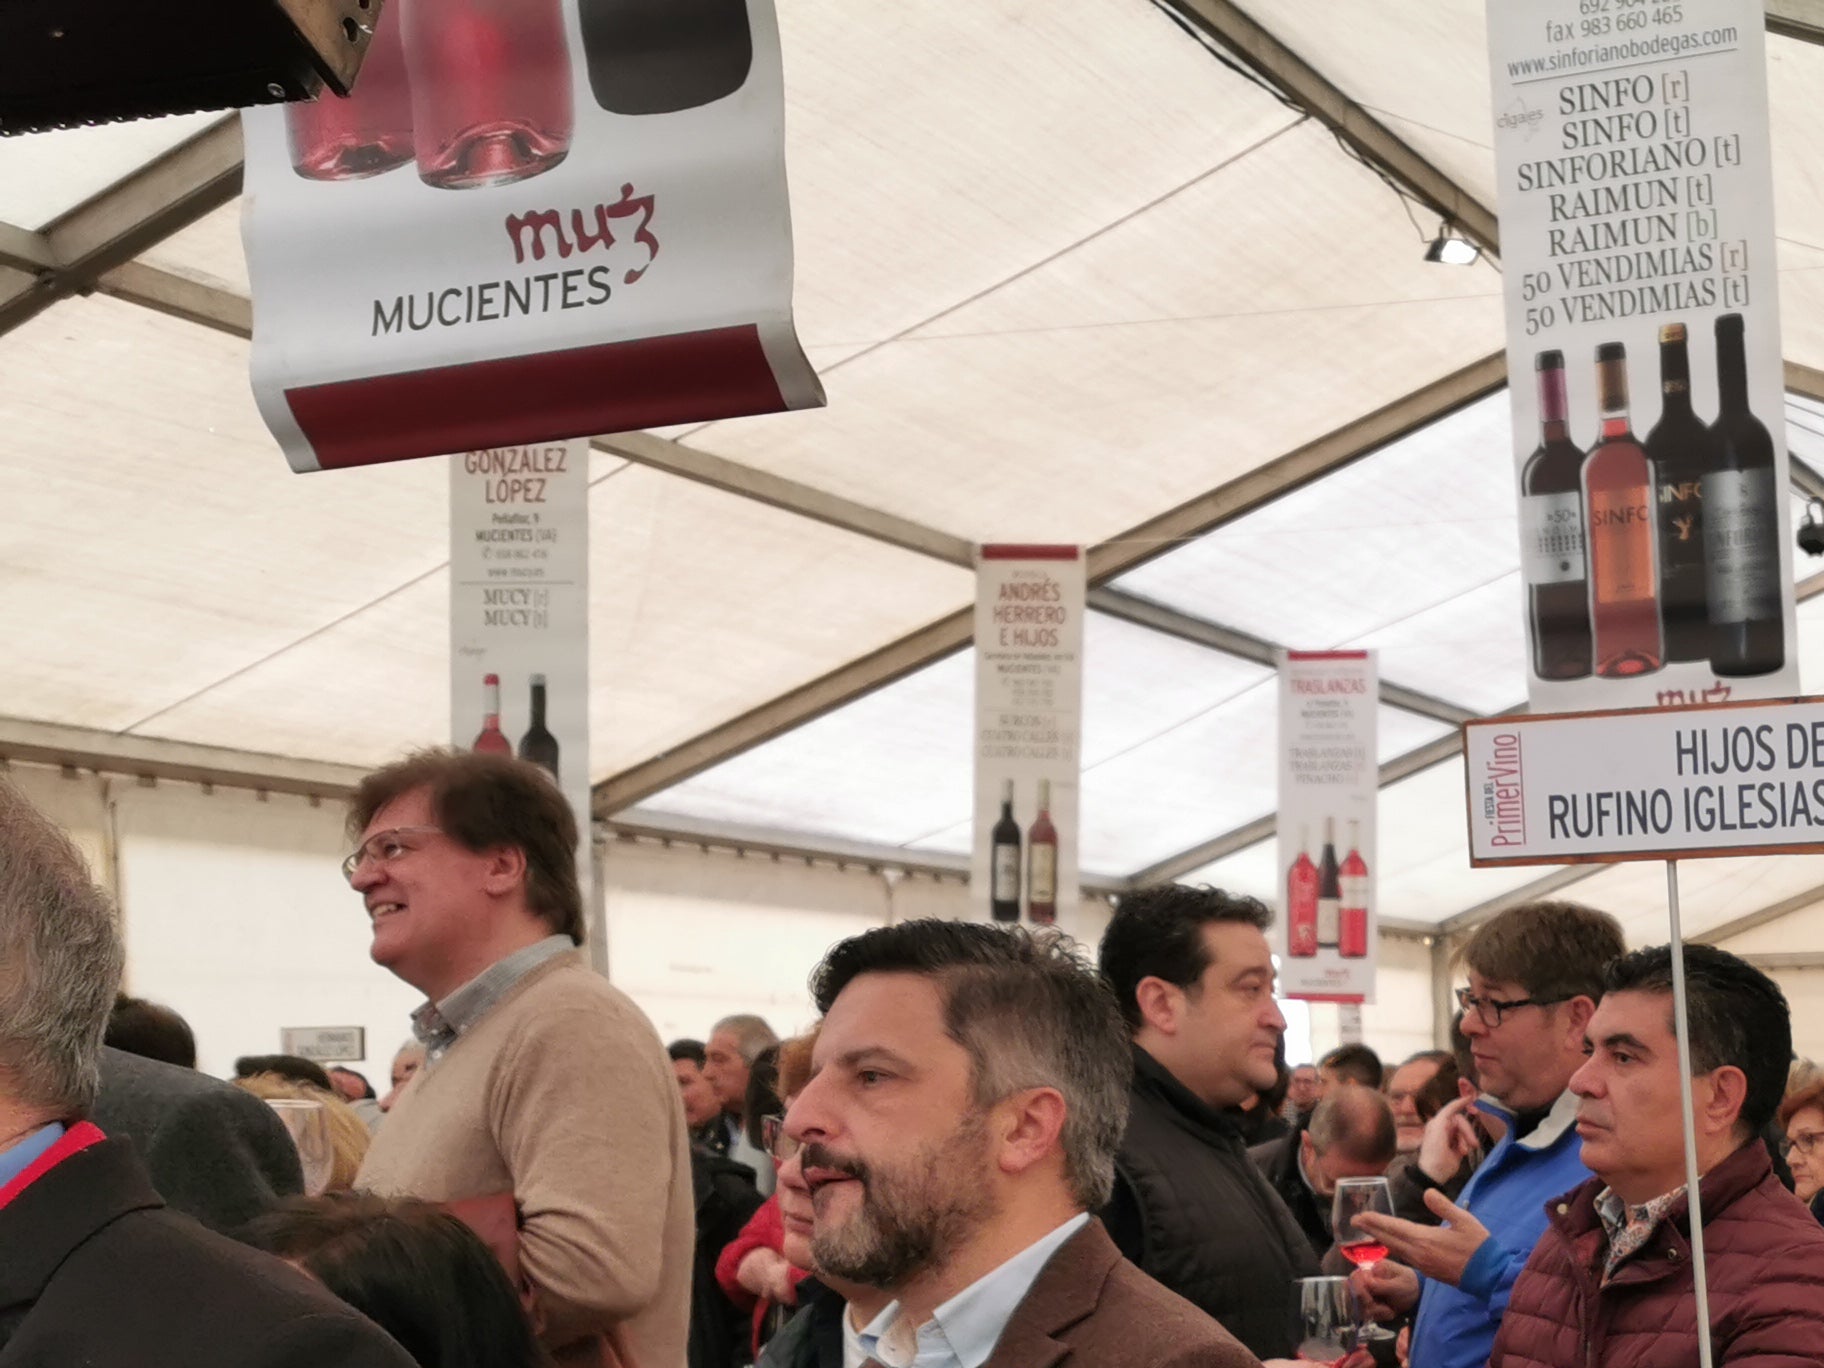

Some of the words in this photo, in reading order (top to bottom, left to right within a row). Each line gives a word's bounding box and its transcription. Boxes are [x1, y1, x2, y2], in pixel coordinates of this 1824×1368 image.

[1546, 20, 1574, 43] fax
[1581, 16, 1611, 38] 983
[1616, 10, 1648, 32] 660
[1652, 5, 1684, 25] 465
[1507, 26, 1738, 77] www.sinforianobodegas.com
[1559, 75, 1654, 116] SINFO
[1661, 70, 1690, 105] [r]
[1562, 110, 1657, 150] SINFO
[1664, 106, 1691, 140] [t]
[1517, 138, 1706, 191] SINFORIANO
[1713, 134, 1741, 168] [t]
[1549, 177, 1679, 222] RAIMUN
[1686, 173, 1713, 207] [t]
[1548, 212, 1678, 257] RAIMUN
[1686, 209, 1718, 242] [b]
[1523, 271, 1551, 301] 50
[1557, 243, 1714, 291] VENDIMIAS
[1720, 240, 1748, 273] [r]
[371, 266, 611, 336] MUCIENTES
[1525, 305, 1555, 336] 50
[1560, 278, 1717, 324] VENDIMIAS
[1722, 275, 1750, 309] [t]
[475, 529, 533, 542] MUCIENTES
[998, 578, 1061, 602] ANDRÉS
[992, 605, 1066, 624] HERRERO
[1013, 628, 1058, 647] HIJOS
[1675, 723, 1776, 775] HIJOS
[1549, 787, 1673, 839] RUFINO
